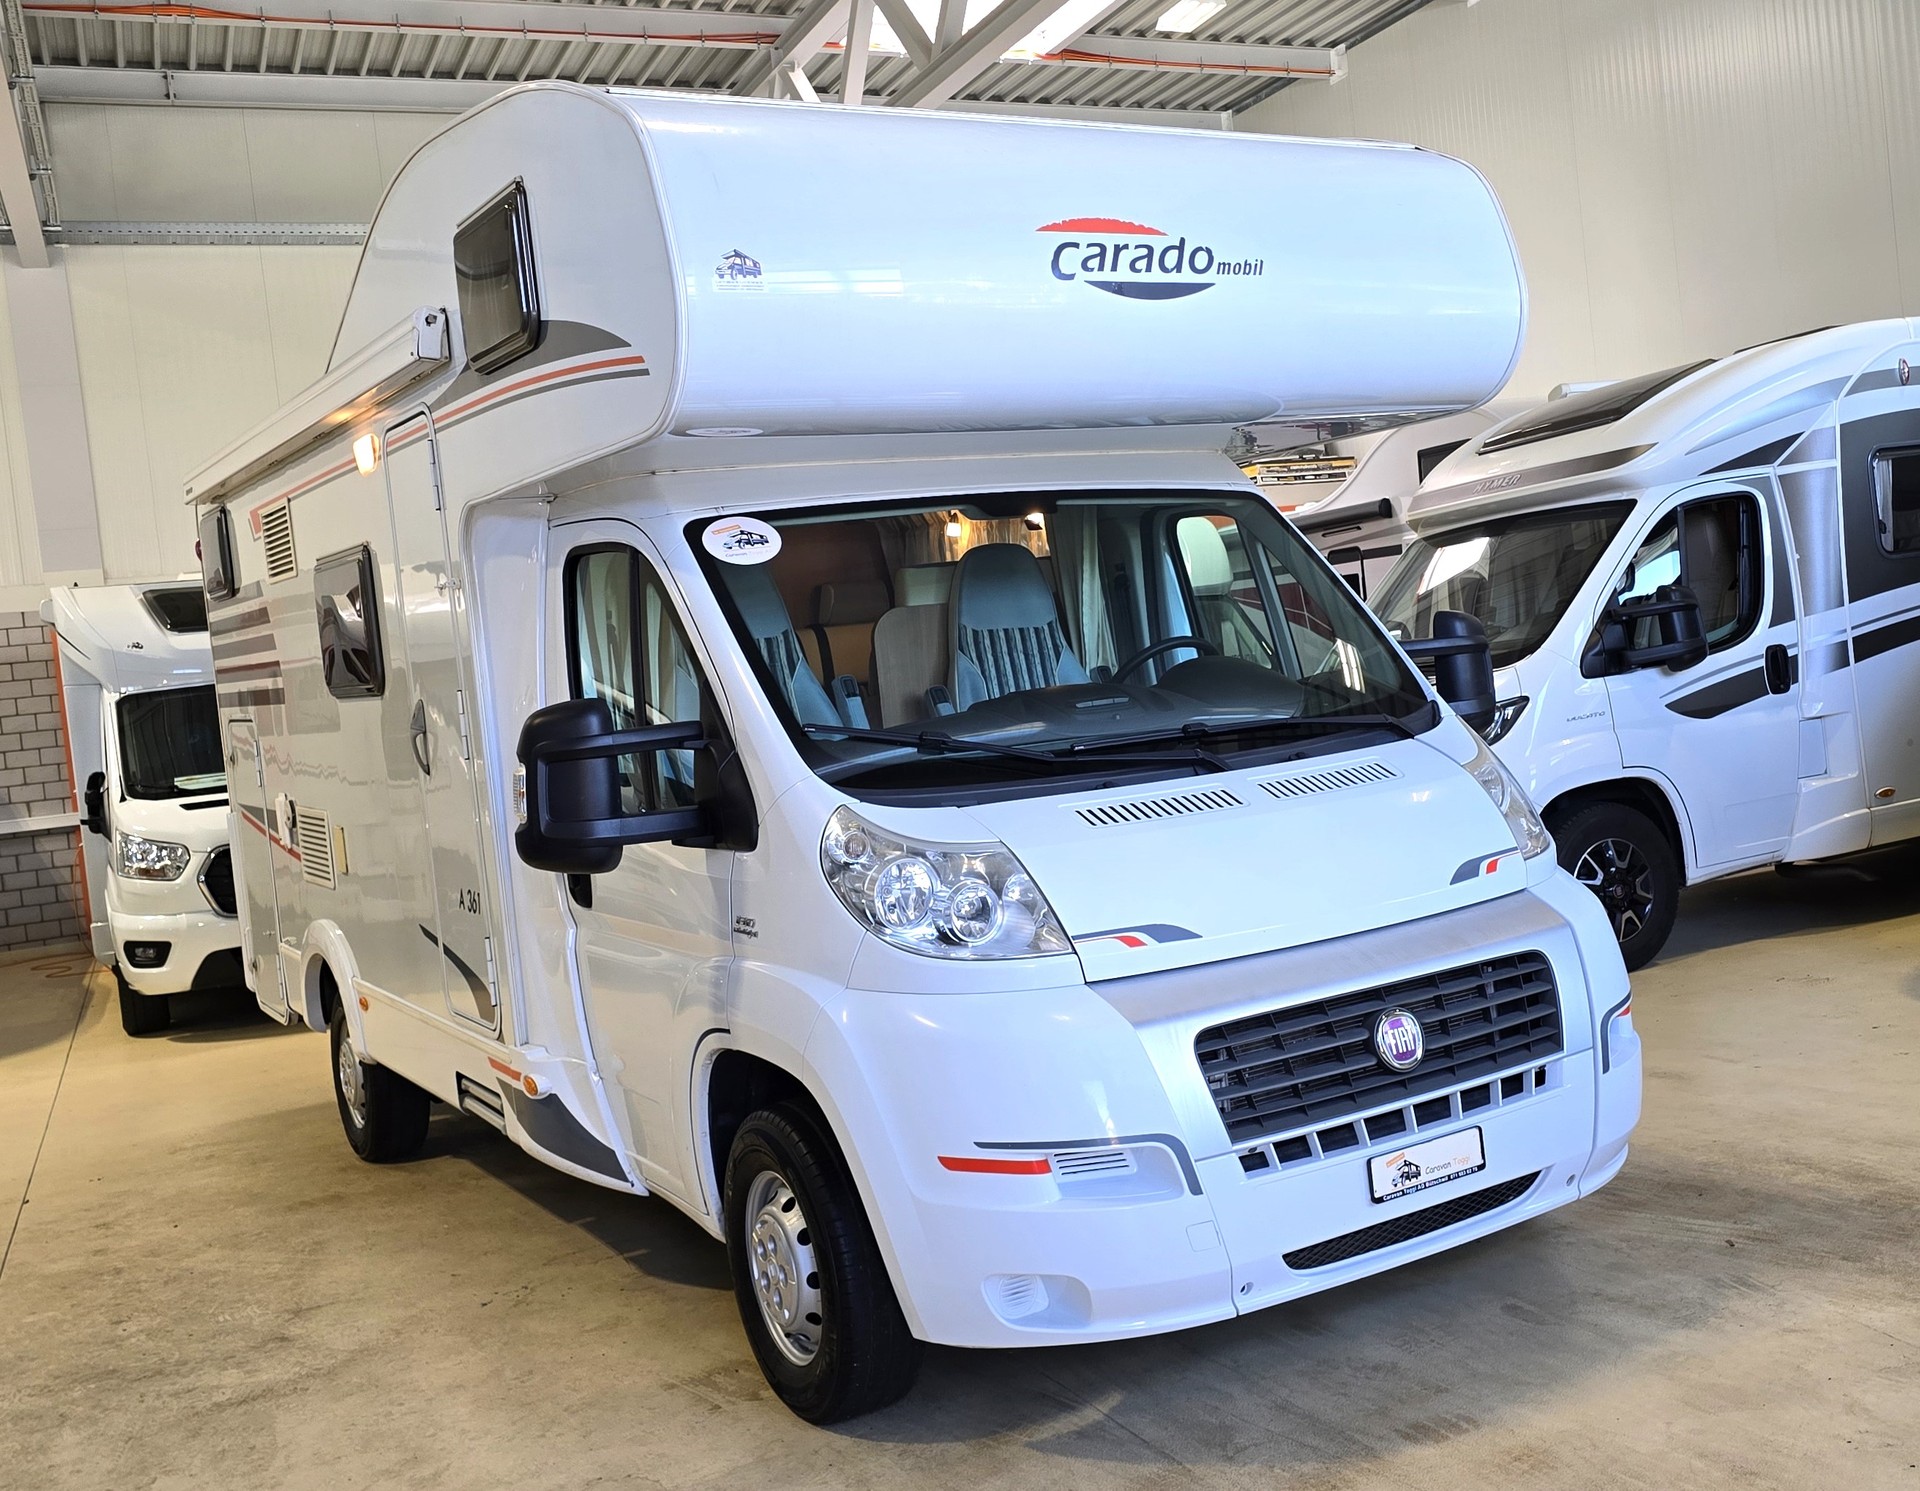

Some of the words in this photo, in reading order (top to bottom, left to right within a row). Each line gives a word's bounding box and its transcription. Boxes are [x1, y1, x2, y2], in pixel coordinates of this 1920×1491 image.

[1051, 236, 1215, 281] carado
[1216, 258, 1264, 276] mobil
[1472, 474, 1522, 494] HYMER
[458, 887, 466, 911] A
[467, 888, 481, 915] 361
[1387, 1024, 1415, 1055] FIAT
[1425, 1161, 1452, 1174] Caravan
